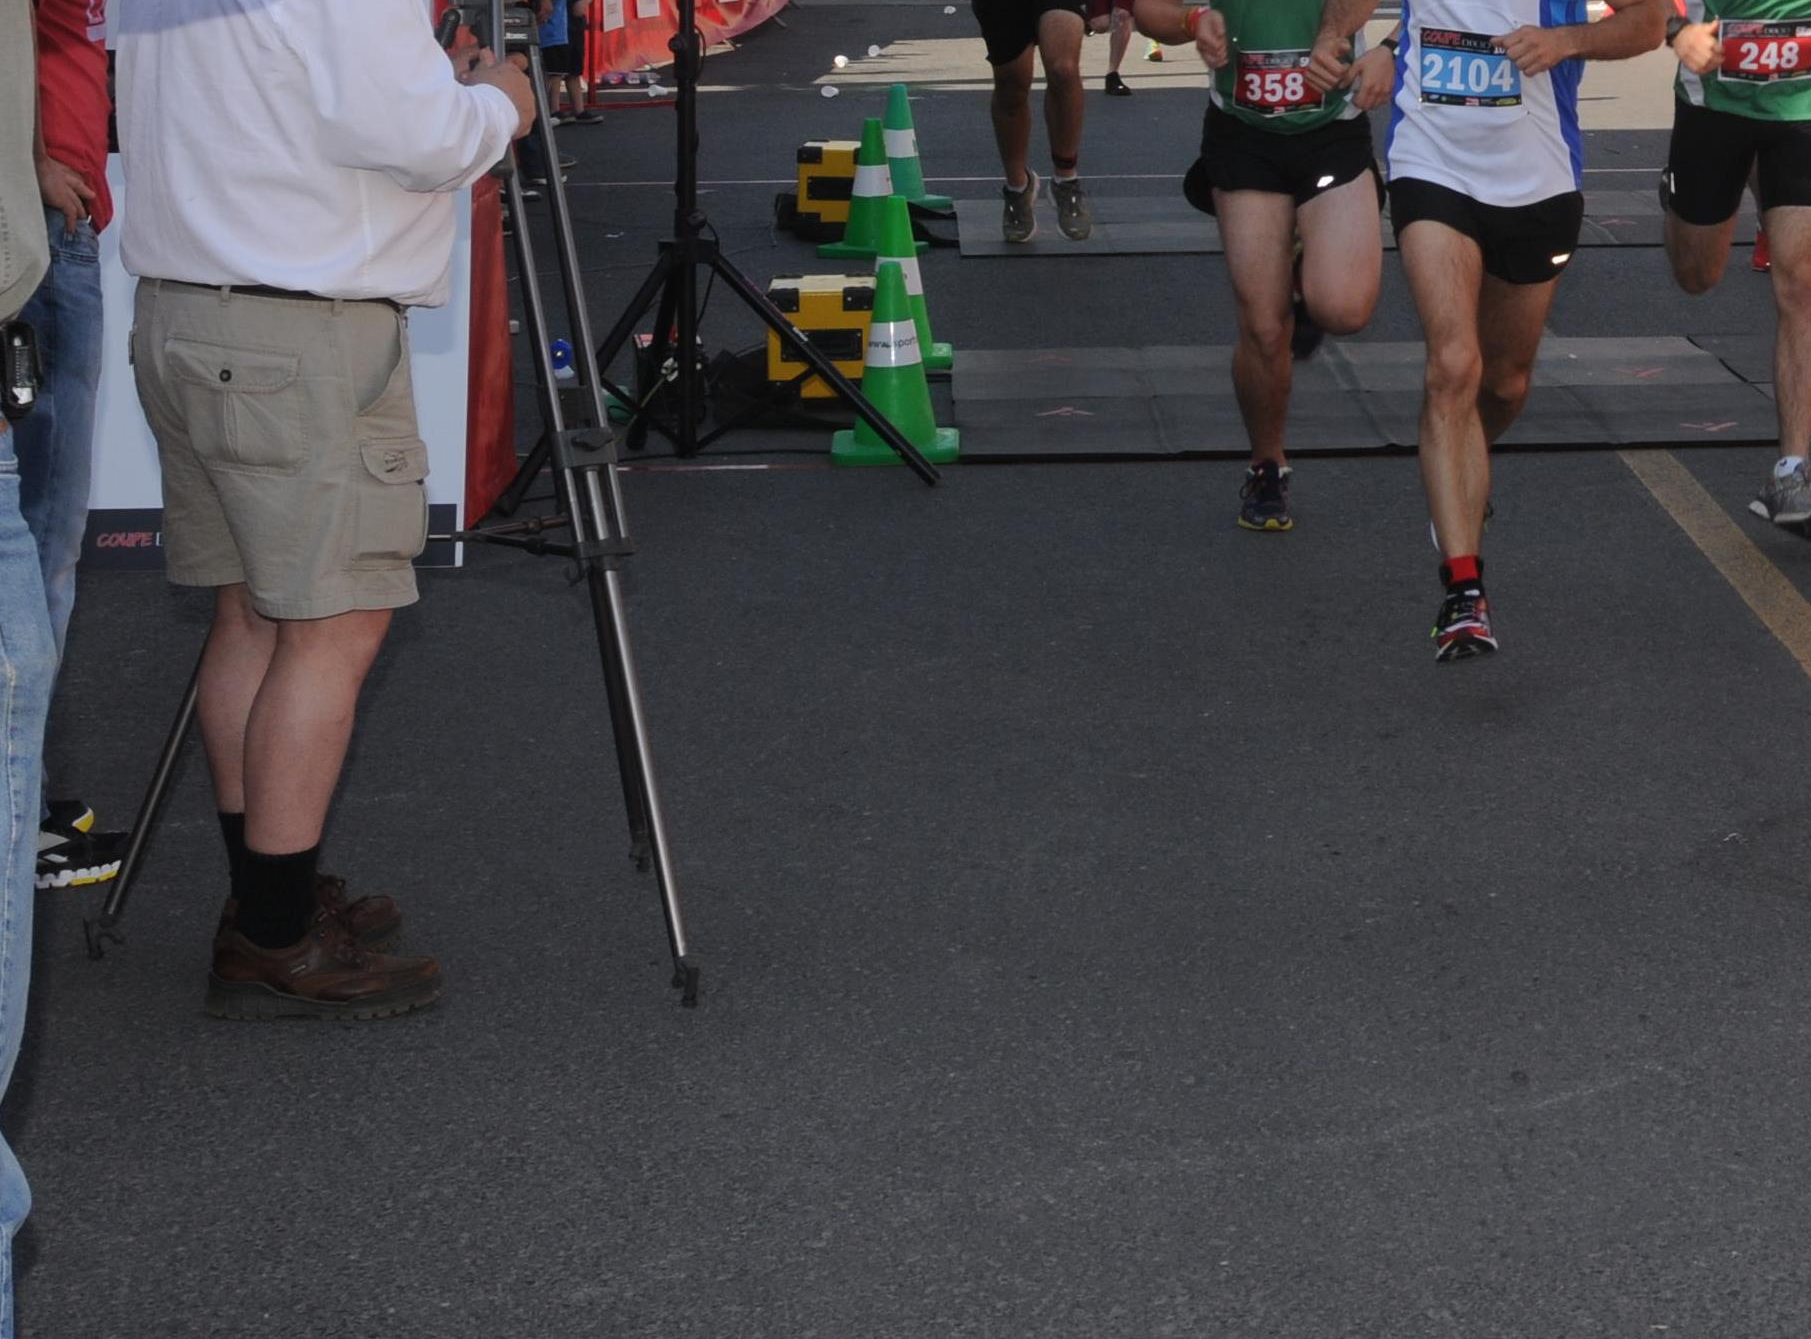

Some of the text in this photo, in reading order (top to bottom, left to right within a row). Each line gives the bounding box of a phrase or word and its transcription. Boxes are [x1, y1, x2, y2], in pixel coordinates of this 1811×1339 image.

[1739, 41, 1799, 70] 248
[1244, 73, 1304, 102] 358
[1422, 53, 1514, 93] 2104
[96, 532, 153, 548] COUPE
